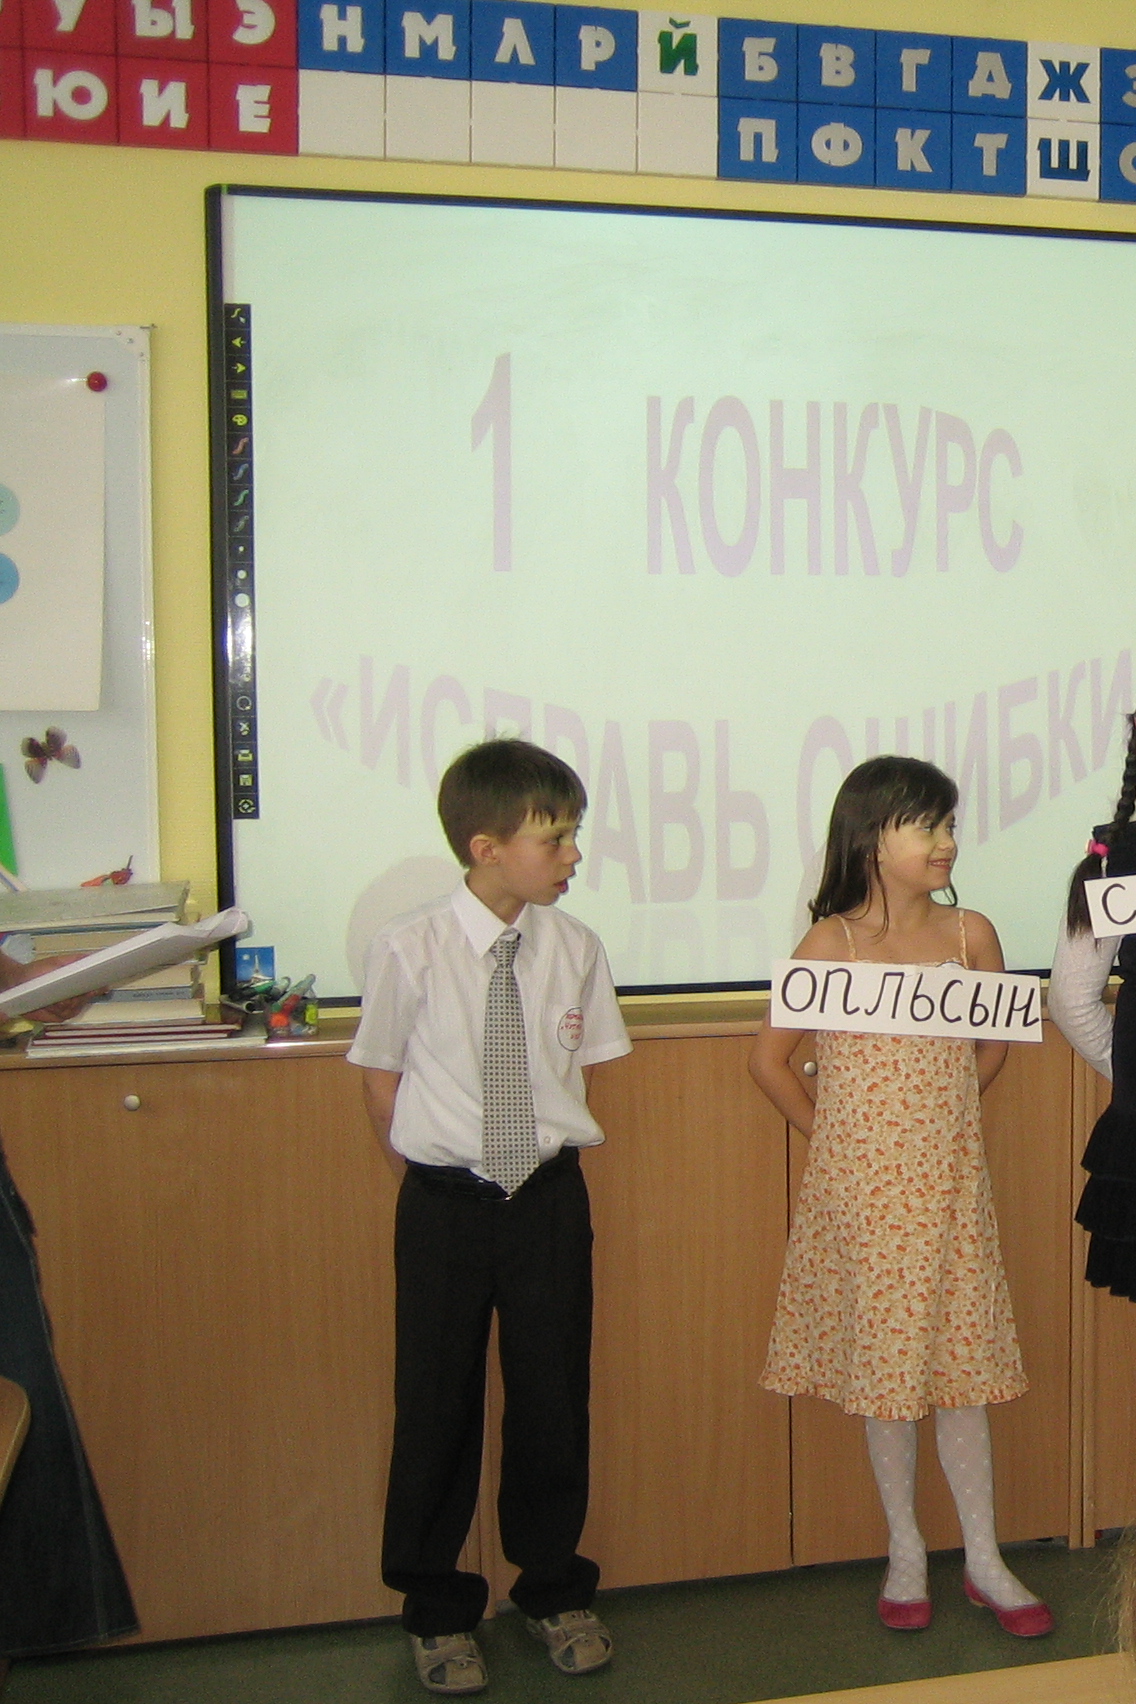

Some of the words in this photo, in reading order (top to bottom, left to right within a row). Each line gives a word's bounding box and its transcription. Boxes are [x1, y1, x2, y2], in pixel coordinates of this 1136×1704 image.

[133, 0, 195, 40] Ы
[232, 0, 276, 45] Э
[320, 4, 365, 53] Н
[401, 11, 457, 61] М
[494, 18, 536, 66] Л
[579, 25, 616, 70] Р
[658, 19, 699, 77] Й
[742, 37, 779, 82] Б
[819, 42, 857, 88] В
[900, 48, 932, 92] Г
[968, 51, 1013, 100] Д
[1038, 58, 1091, 104] Ж
[33, 68, 108, 121] Ю
[139, 79, 190, 129] И
[236, 84, 272, 133] Е
[737, 117, 779, 163] П
[811, 121, 863, 167] Ф
[894, 127, 933, 173] К
[973, 132, 1009, 177] Т
[1037, 137, 1091, 182] Ш
[470, 351, 512, 573] 1
[645, 395, 1025, 578] КОНКУРС
